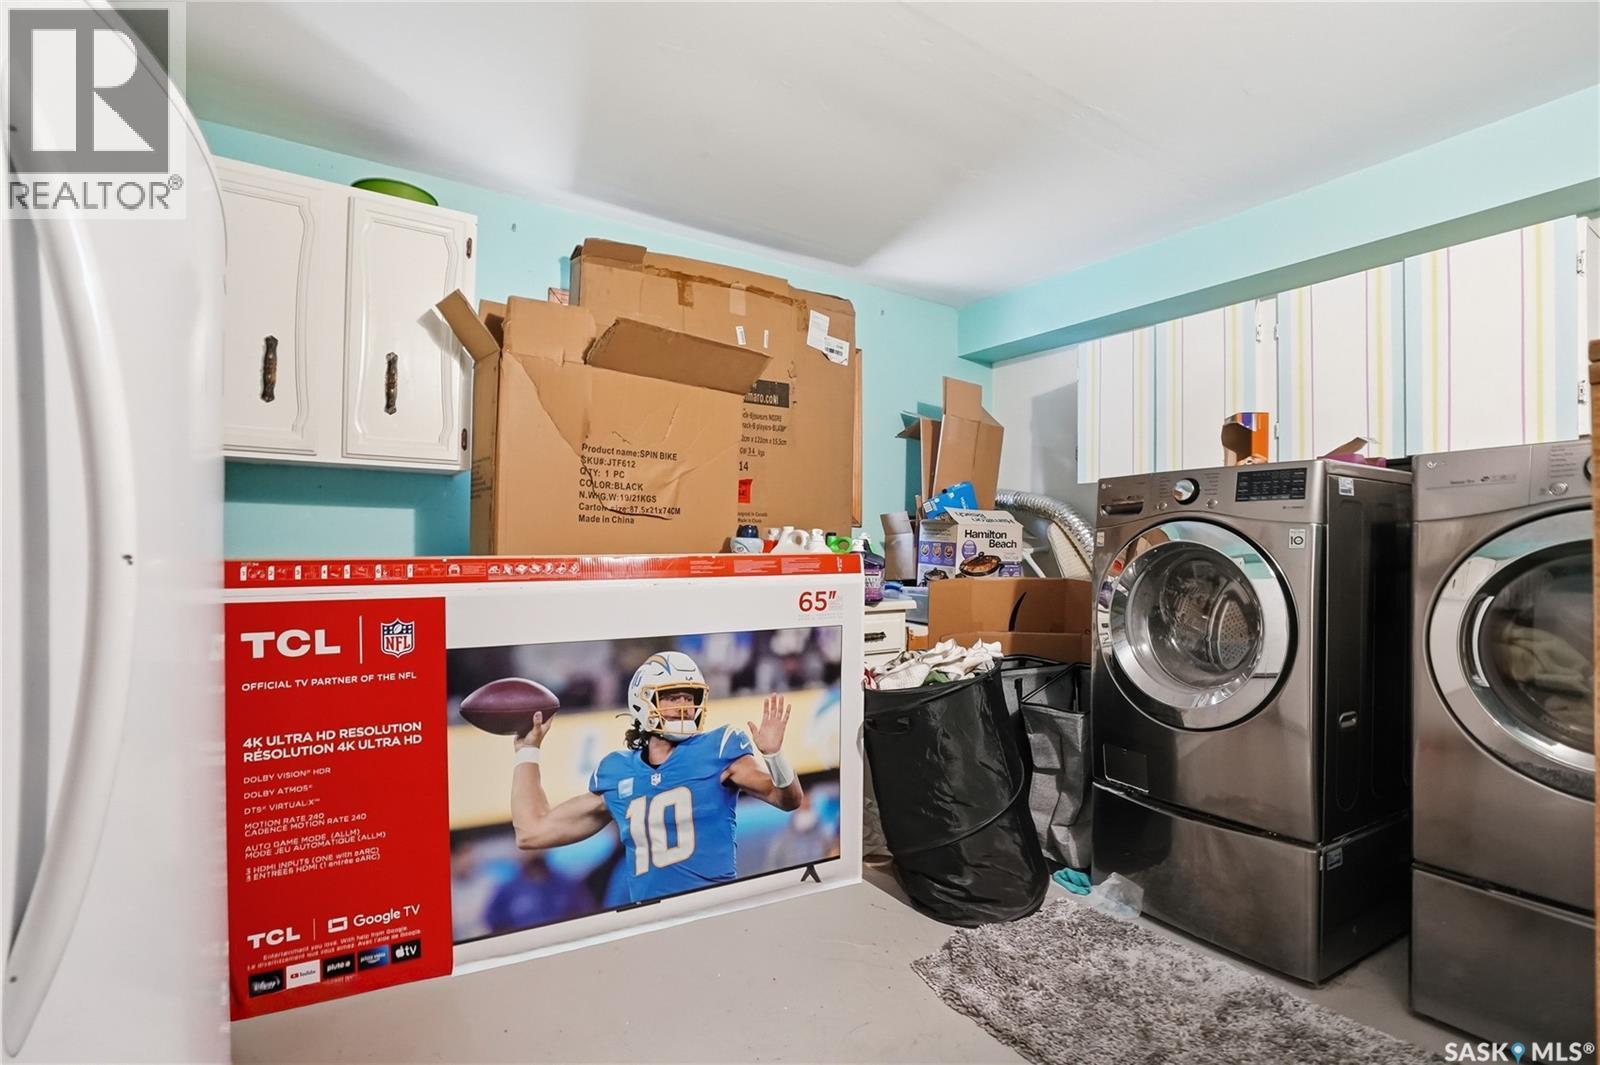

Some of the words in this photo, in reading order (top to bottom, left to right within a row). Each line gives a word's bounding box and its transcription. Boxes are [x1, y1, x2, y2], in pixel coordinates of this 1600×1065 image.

[581, 442, 618, 455] Product
[620, 447, 658, 459] name:SPIN
[659, 452, 678, 461] BIKE
[580, 466, 601, 478] QTY:
[613, 470, 625, 478] PC
[739, 461, 749, 471] 14
[579, 478, 643, 491] COLOR:BLACK
[578, 502, 608, 512] Carton
[578, 514, 601, 523] Made
[602, 514, 609, 523] in
[611, 515, 635, 524] China
[964, 529, 1007, 540] Hamilton
[989, 539, 1017, 549] Beach
[240, 629, 340, 659] TCL
[385, 634, 411, 652] NFL
[241, 680, 292, 692] OFFICIAL
[294, 679, 309, 687] TV
[311, 675, 358, 687] PARTNER
[360, 674, 374, 683] OF
[377, 673, 395, 682] THE
[398, 671, 417, 680] NFL
[242, 737, 263, 749] 4K
[266, 732, 313, 747] ULTRA
[316, 730, 335, 740] HD
[340, 721, 422, 739] RESOLUTION
[243, 742, 334, 762] RÉSOLUTION
[337, 741, 355, 753] 4K
[358, 736, 401, 751] ULTRA
[404, 734, 423, 745] HD
[243, 774, 275, 785] DOLBY
[312, 767, 331, 775] HDR
[243, 789, 275, 800] DOLBY
[244, 818, 281, 830] MOTION
[282, 815, 306, 824] RATE
[308, 812, 325, 820] 240
[244, 825, 288, 837] CADENCE
[290, 819, 325, 831] MOTION
[326, 815, 349, 825] RATE
[351, 812, 367, 821] 240
[626, 786, 695, 877] 10
[245, 842, 271, 853] AUTO
[273, 836, 299, 847] GAME
[301, 833, 327, 843] MODE
[331, 829, 361, 839] (ALLM)
[245, 850, 272, 860] MODE
[274, 846, 290, 854] JEU
[292, 836, 356, 851] AUTOMATIQUE
[357, 831, 386, 842] (ALLM)
[253, 863, 277, 873] HDMI
[278, 857, 310, 869] INPUTS
[311, 855, 334, 865] (ONE
[336, 850, 353, 859] with
[295, 863, 318, 874] HDMI
[353, 908, 400, 928] Google
[403, 903, 420, 916] TV
[247, 926, 301, 949] TCL
